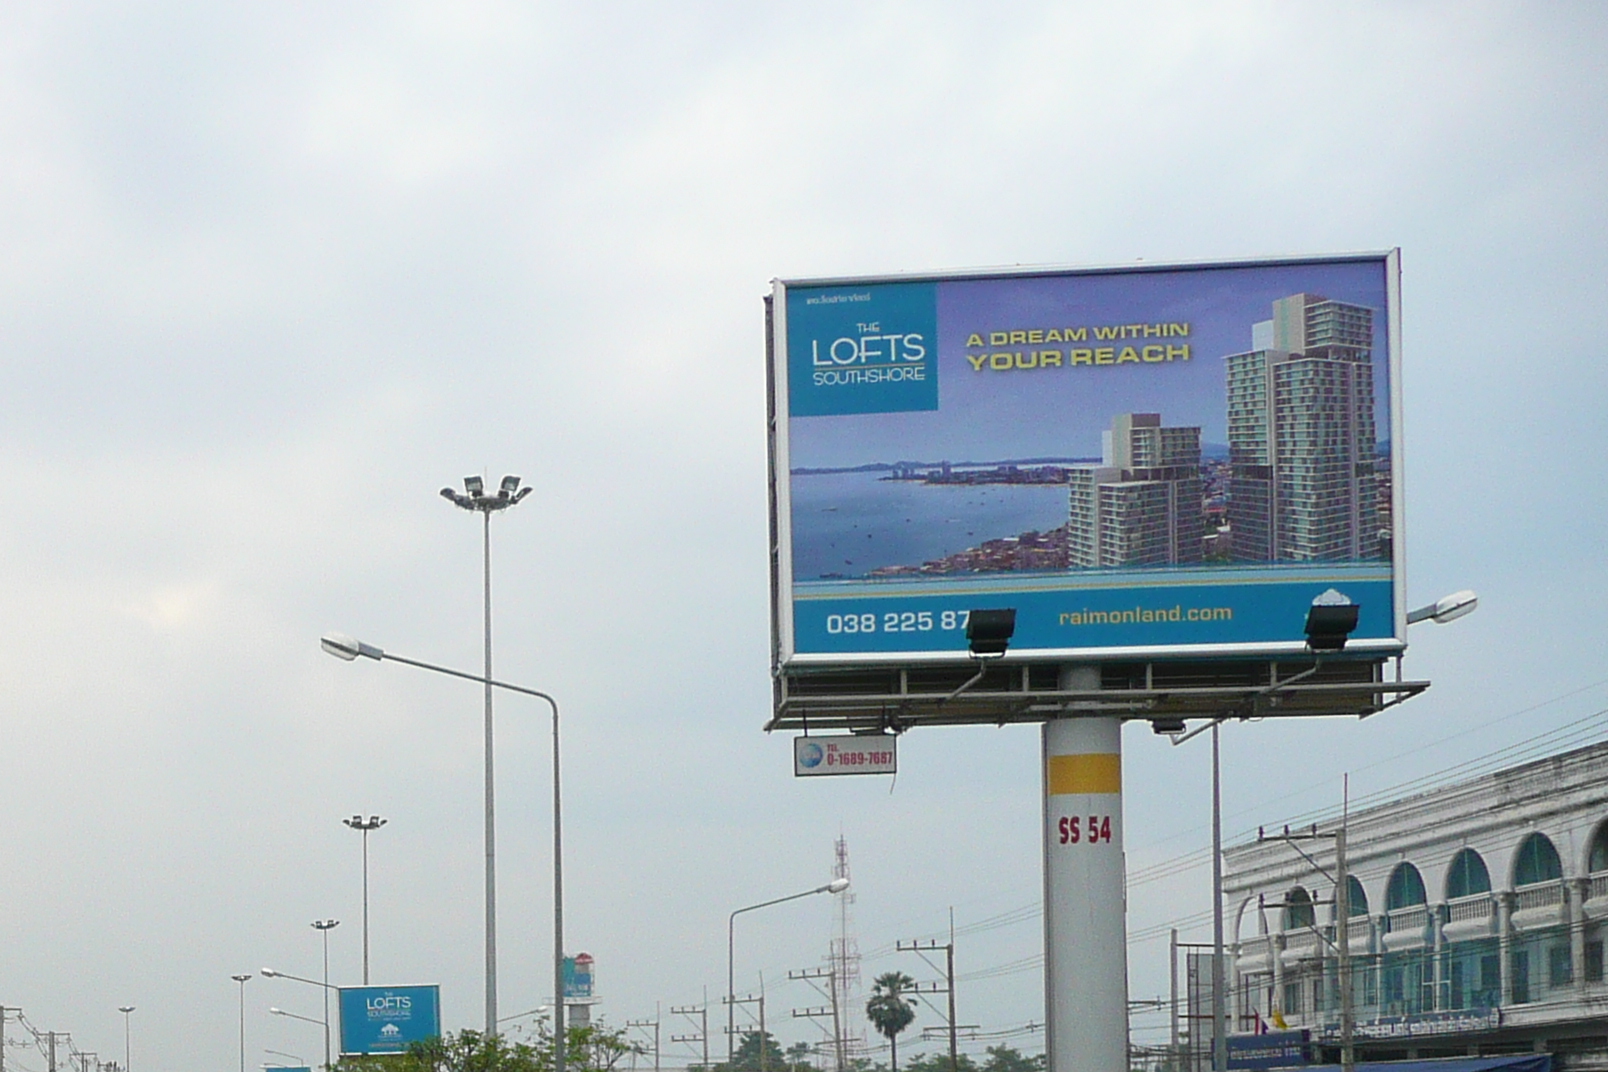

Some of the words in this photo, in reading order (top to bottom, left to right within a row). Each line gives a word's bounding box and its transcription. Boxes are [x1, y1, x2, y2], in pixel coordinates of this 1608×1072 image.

[856, 322, 880, 333] THE
[966, 334, 984, 347] A
[990, 328, 1087, 346] DREAM
[1093, 323, 1189, 339] WITHIN
[812, 334, 925, 365] LOFTS
[967, 350, 1063, 371] YOUR
[1070, 344, 1190, 366] REACH
[813, 367, 925, 386] SOUTHSHORE
[826, 614, 876, 633] 038
[884, 612, 933, 632] 225
[1059, 605, 1233, 625] raimonland.com
[1059, 816, 1080, 845] SS
[1088, 815, 1111, 844] 54
[366, 996, 411, 1010] LOFTS
